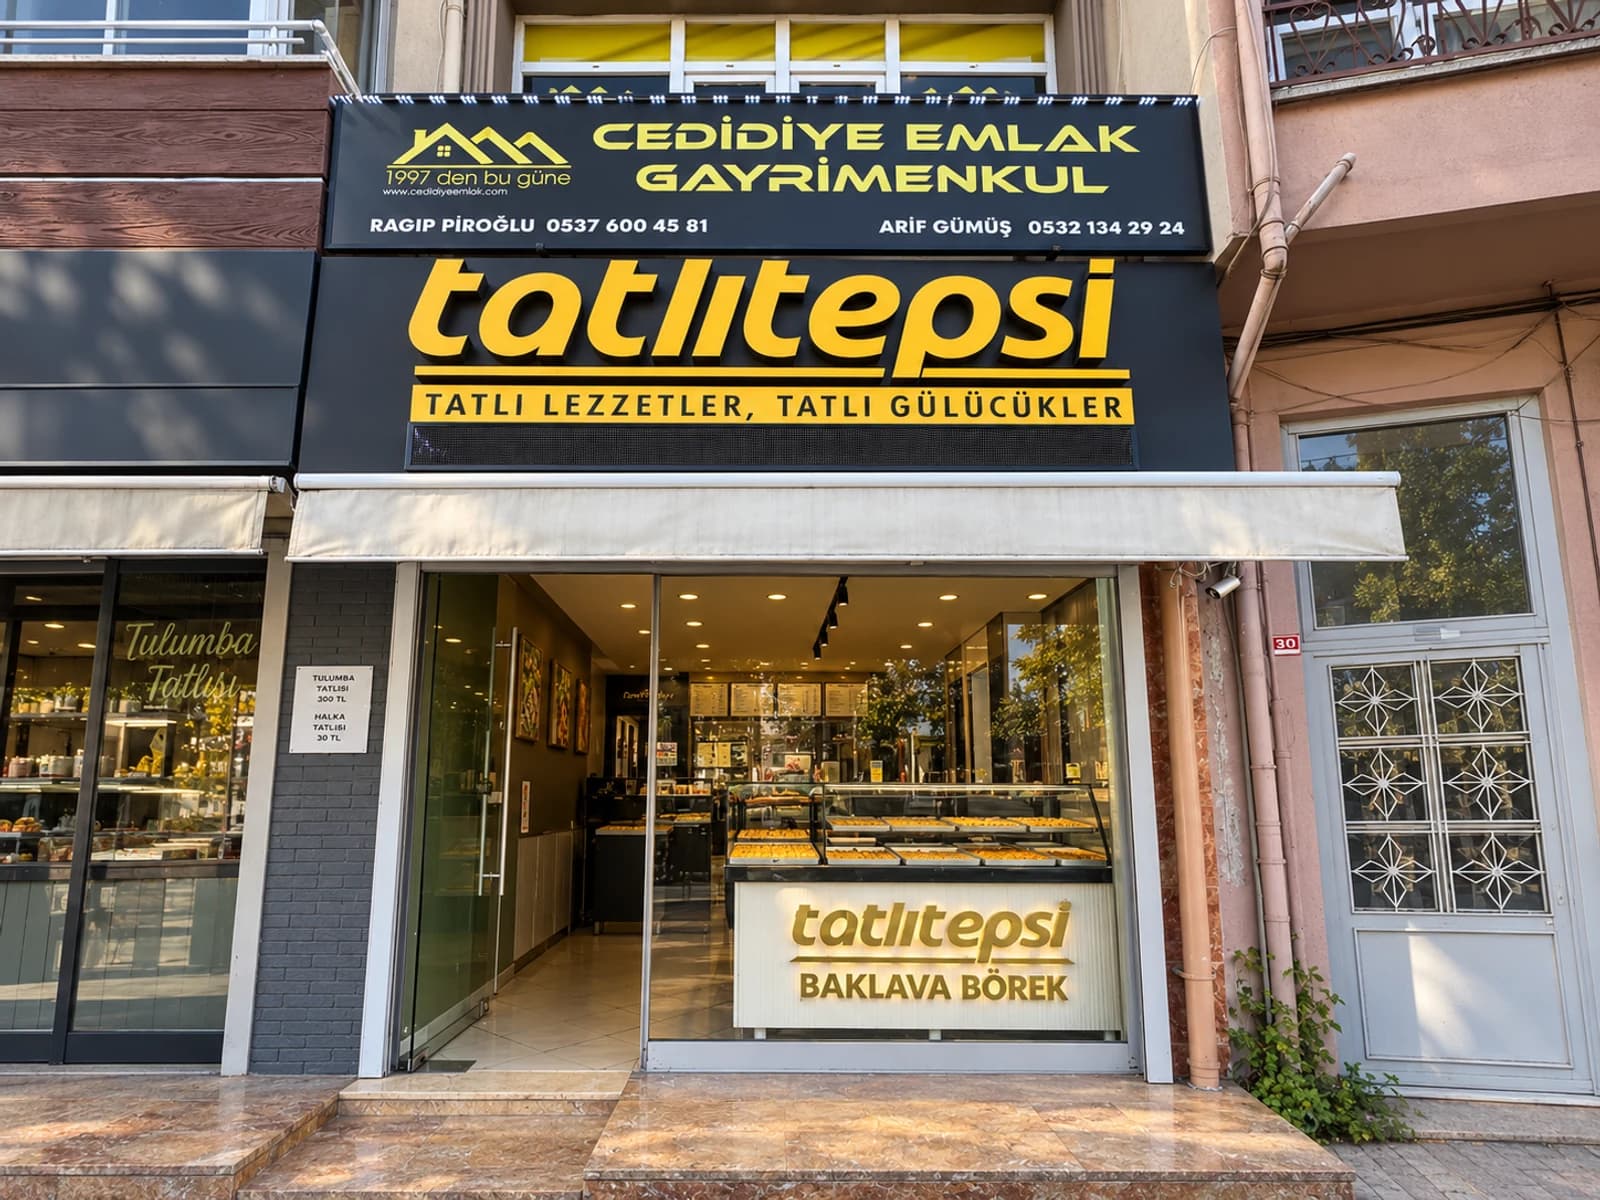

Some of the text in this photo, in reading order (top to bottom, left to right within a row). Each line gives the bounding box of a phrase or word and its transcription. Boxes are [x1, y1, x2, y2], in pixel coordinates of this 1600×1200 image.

[593, 115, 1140, 152] CEDİDİYE EMLAK
[386, 170, 571, 189] 1997 den bu güne
[635, 157, 1110, 194] GAYRİMENKUL
[382, 187, 508, 197] www.cedidiyeemlak.com
[370, 215, 708, 233] RAGIP PİROĞLU 0537 600 45 81
[879, 216, 1185, 238] ARİF GÜMÜŞ 0532 134 29 24
[425, 391, 1123, 421] TATLI LEZZETLER, TATLI GÜLÜCÜKLER
[126, 621, 258, 661] Tulumba
[1275, 638, 1296, 649] 30
[148, 663, 241, 702] Tatlısı
[312, 674, 355, 682] TULUMBA
[317, 695, 347, 703] 300 TL
[314, 713, 346, 721] HALKA
[313, 724, 346, 732] TATLISI
[317, 734, 341, 742] 30 TL
[800, 968, 1069, 1001] BAKLAVA BÖREK
